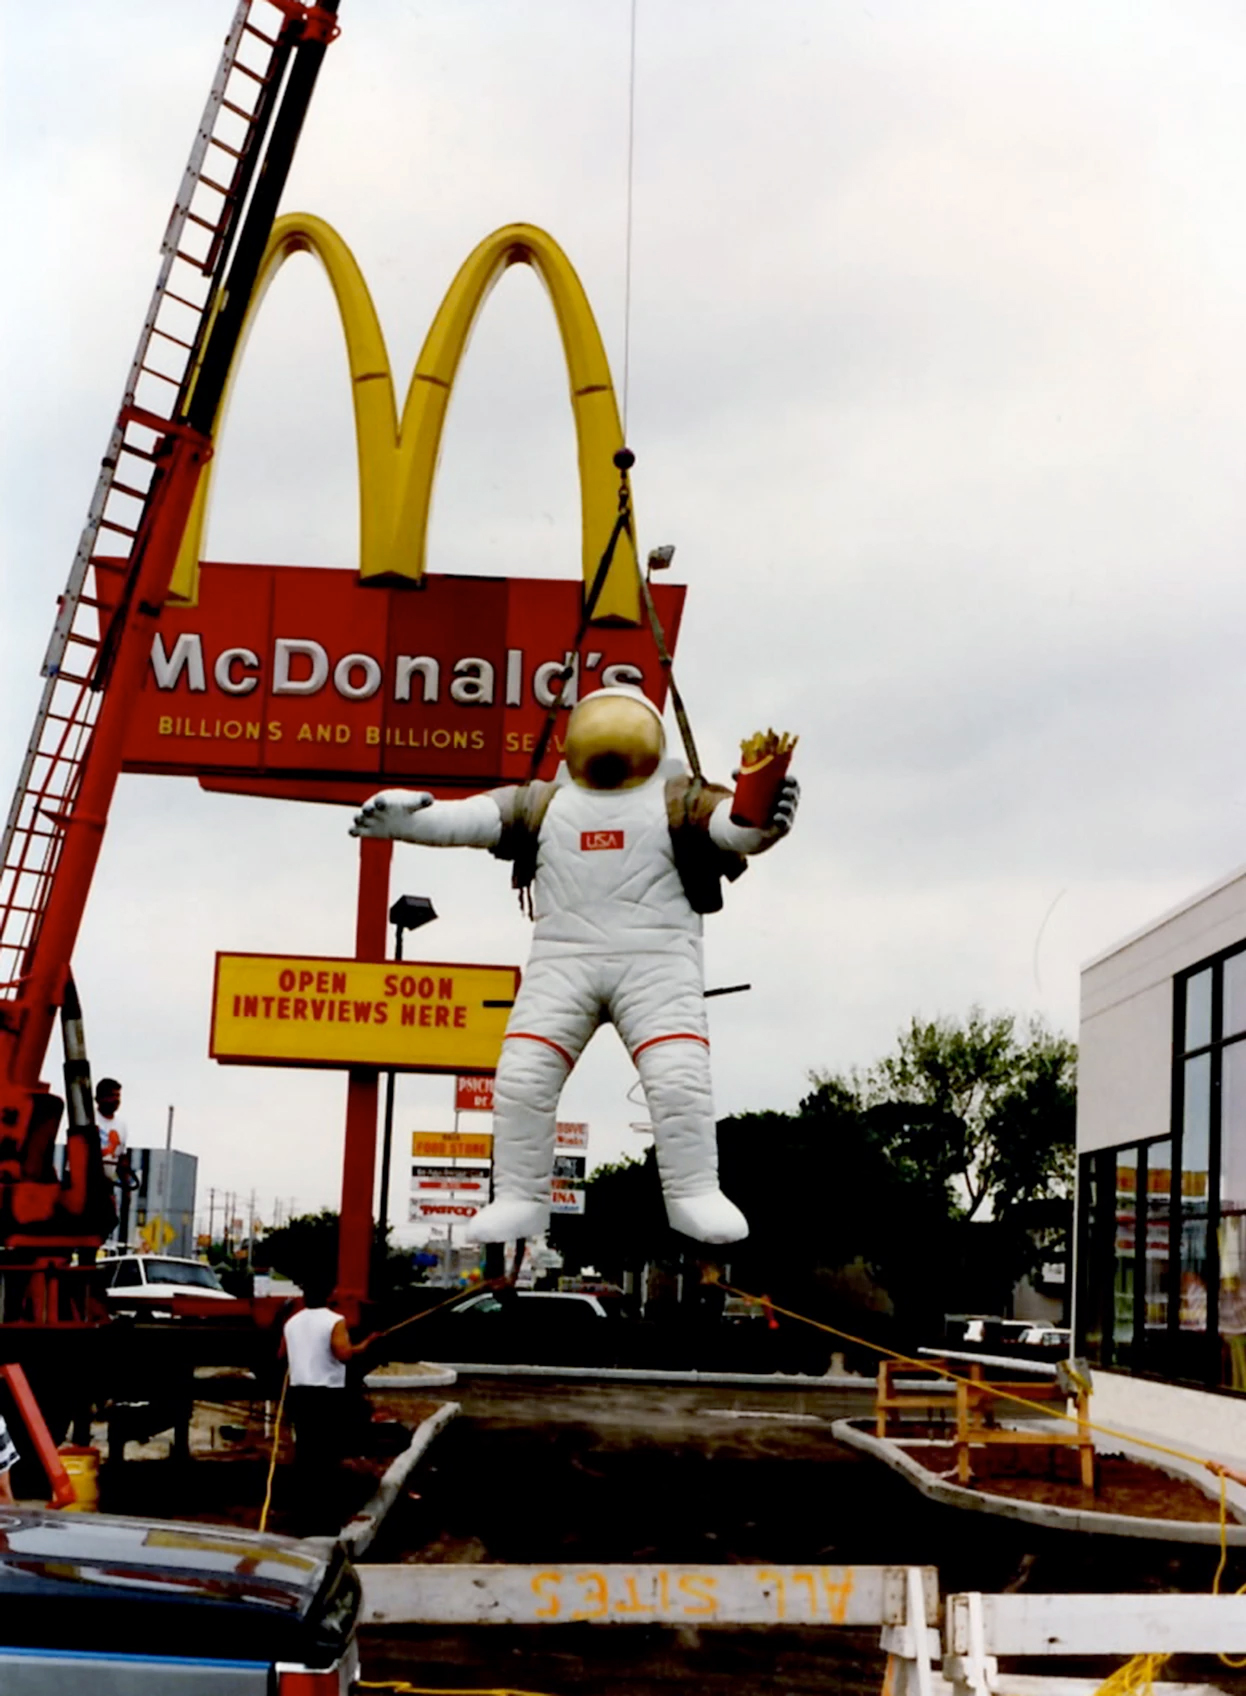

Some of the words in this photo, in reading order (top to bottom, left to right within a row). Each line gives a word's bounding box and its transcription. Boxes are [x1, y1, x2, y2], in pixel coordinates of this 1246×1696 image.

[149, 632, 643, 709] McDonald's
[158, 716, 283, 742] BILLIONS
[296, 723, 351, 745] AND
[366, 725, 485, 750] BILLIONS
[586, 833, 617, 850] USA
[279, 968, 347, 995] OPEN
[384, 974, 453, 1001] SOON
[232, 995, 389, 1025] INTERVIEWS
[401, 1004, 468, 1029] HERE
[530, 1570, 719, 1621] SITES
[757, 1567, 855, 1625] ALL
